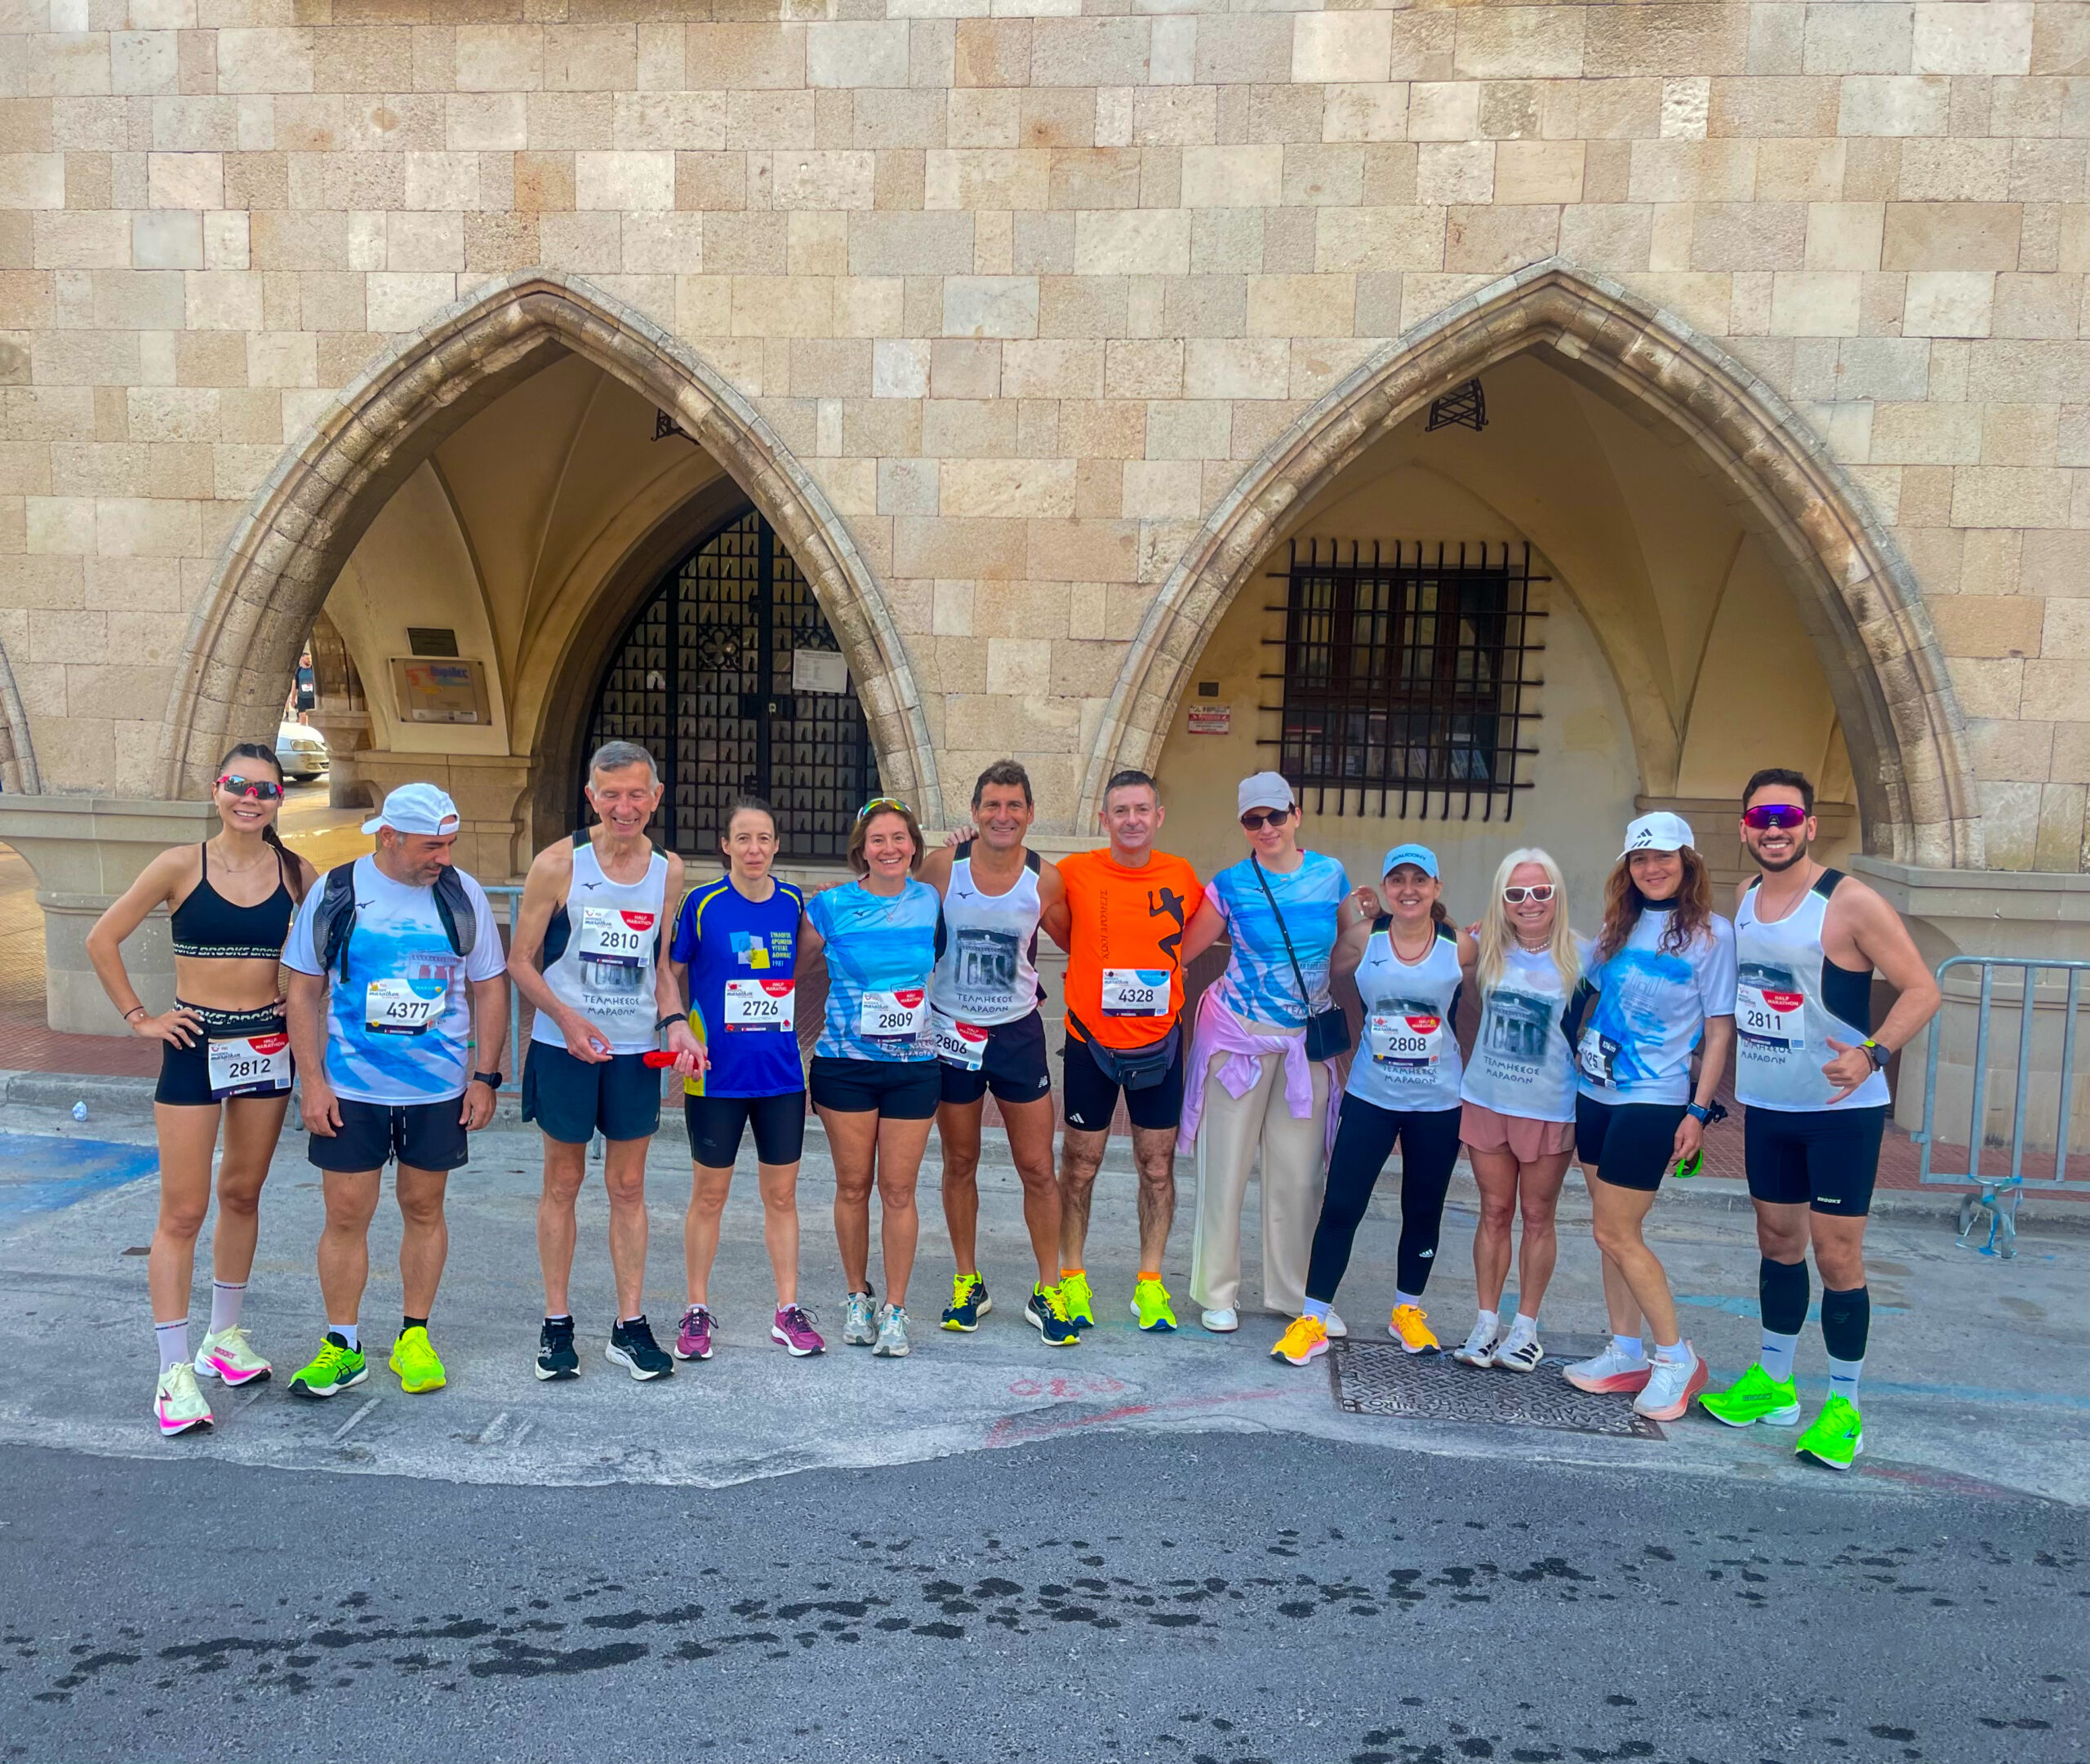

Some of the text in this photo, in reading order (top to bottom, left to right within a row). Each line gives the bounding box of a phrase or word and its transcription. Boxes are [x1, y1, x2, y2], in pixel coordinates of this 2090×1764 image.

[600, 931, 638, 949] 2810
[198, 947, 250, 956] BROOKS
[583, 993, 640, 1006] ΤΕΛΜΗΣΣΟΣ
[957, 993, 1012, 1003] ΤΕΛΜΗΣΣΟΣ
[1118, 989, 1154, 1002] 4328
[386, 1002, 429, 1018] 4377
[588, 1007, 636, 1015] ΜΑΡΑΘΩΝ
[743, 1001, 778, 1015] 2726
[962, 1004, 1008, 1013] ΜΑΡΑΘΩΝ
[878, 1011, 913, 1029] 2809
[1748, 1010, 1781, 1030] 2811
[936, 1033, 967, 1055] 2806
[1389, 1037, 1426, 1051] 2808
[229, 1058, 271, 1078] 2812
[1483, 1055, 1541, 1076] ΤΕΛΜΗΣΣΟΣ
